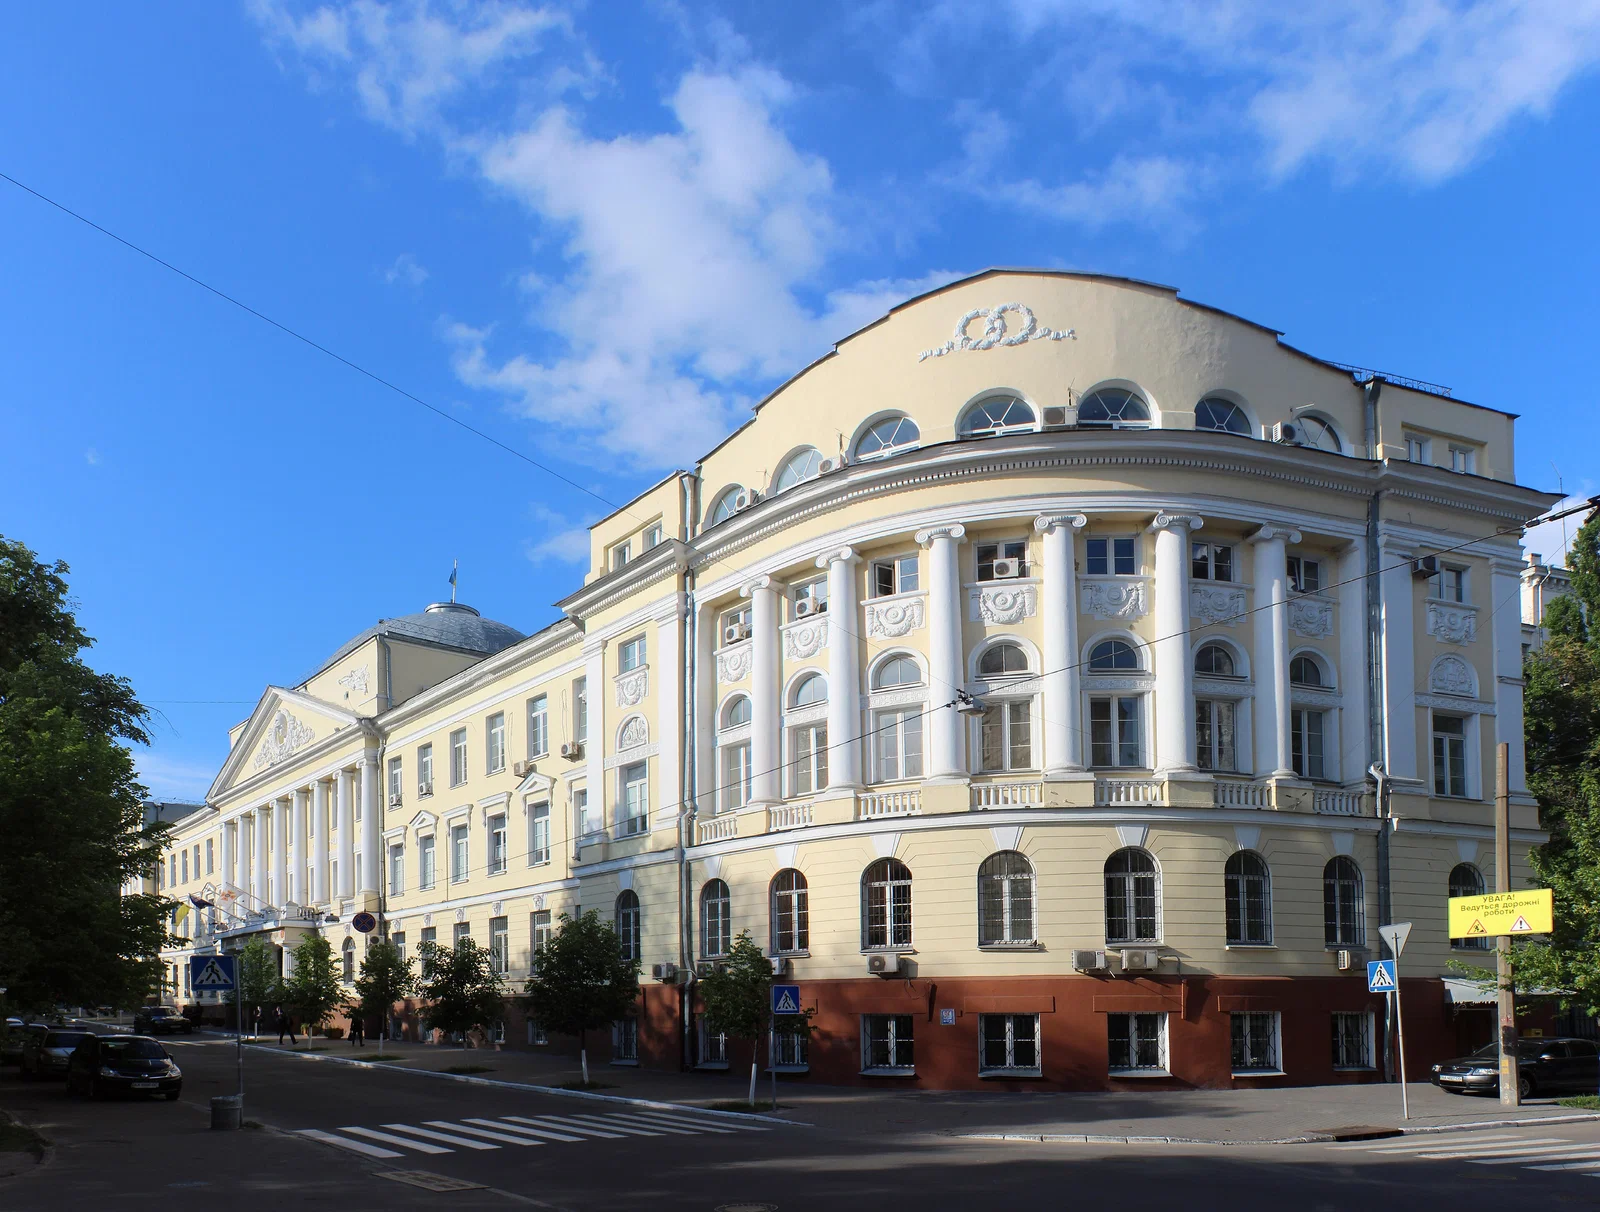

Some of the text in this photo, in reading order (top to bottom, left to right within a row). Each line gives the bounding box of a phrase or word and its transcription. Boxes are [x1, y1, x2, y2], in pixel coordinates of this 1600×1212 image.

[1483, 894, 1515, 902] УВАГА!
[1461, 899, 1540, 912] Ведуться дорожні
[1484, 909, 1514, 917] роботи
